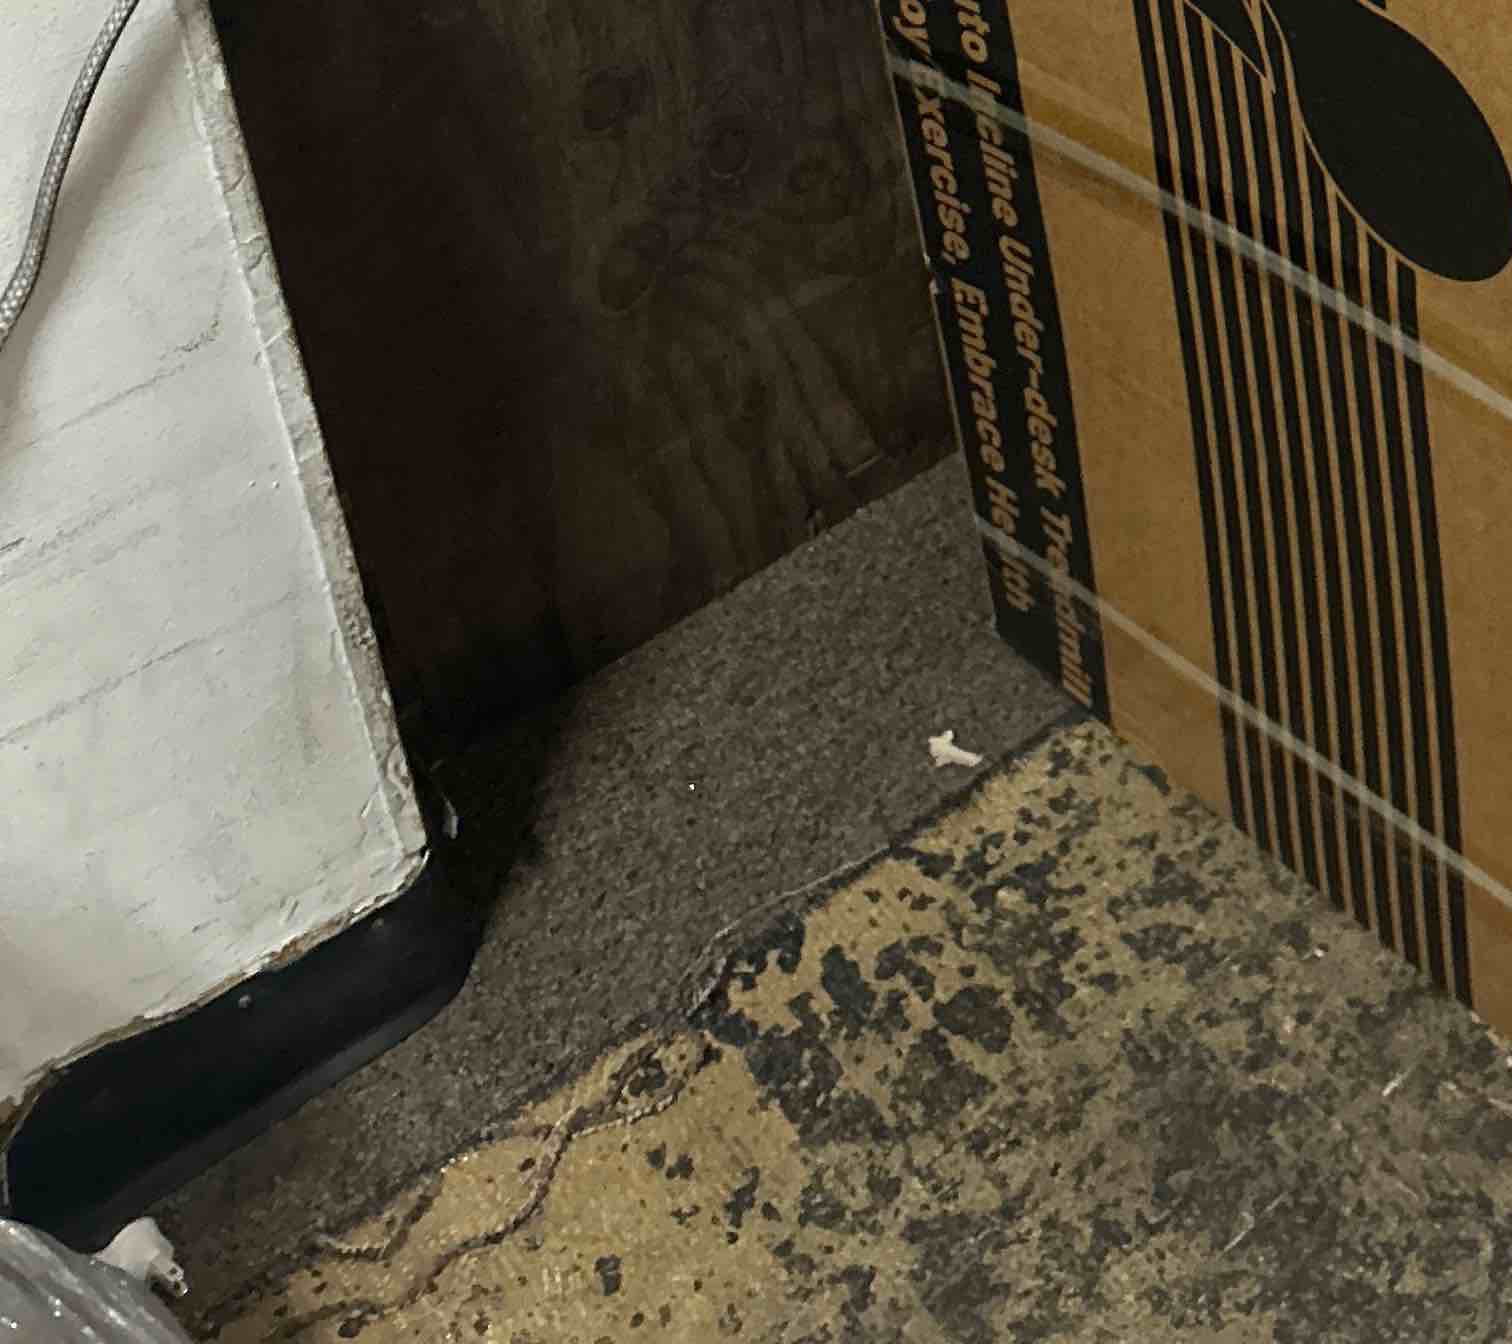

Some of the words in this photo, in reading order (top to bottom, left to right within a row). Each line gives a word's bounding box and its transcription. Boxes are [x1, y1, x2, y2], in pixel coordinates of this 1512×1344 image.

[910, 60, 971, 267] Exercise,
[950, 276, 1006, 473] Embrace
[985, 474, 1036, 613] Helth
[966, 68, 1020, 229] Incline
[1001, 234, 1068, 501] Under-desk
